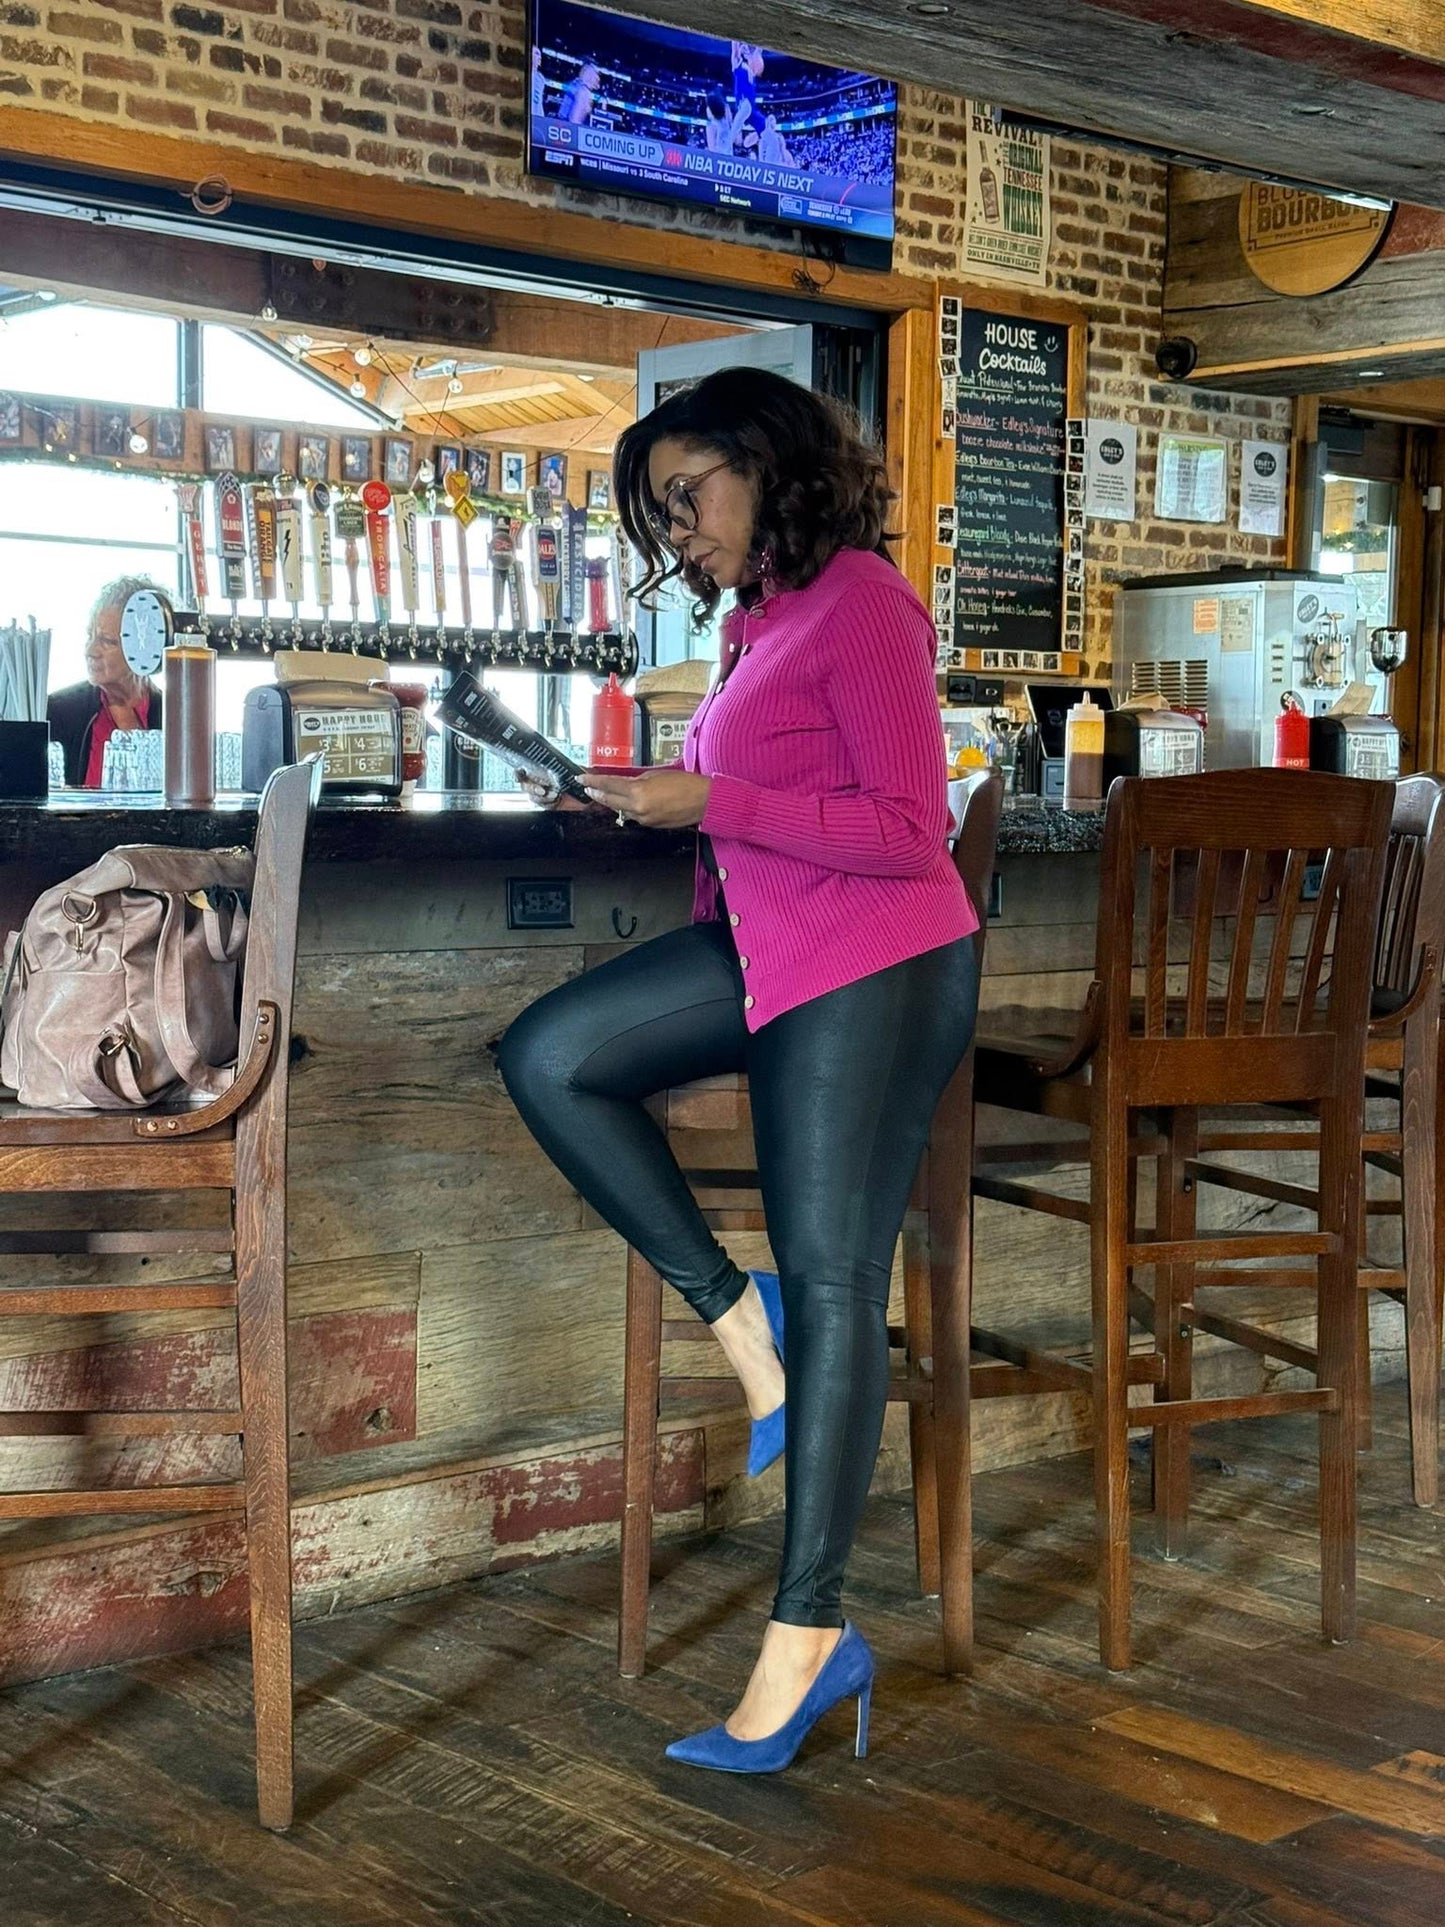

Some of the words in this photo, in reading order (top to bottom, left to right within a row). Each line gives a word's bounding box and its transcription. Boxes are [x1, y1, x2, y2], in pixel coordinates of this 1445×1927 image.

[548, 126, 572, 143] SC
[585, 133, 635, 155] COMING
[638, 145, 656, 159] UP
[1008, 142, 1044, 175] ORIGINAL
[602, 161, 629, 175] Missouri
[644, 169, 662, 181] South
[663, 173, 689, 186] Carolina
[684, 153, 713, 174] NBA
[717, 160, 761, 182] TODAY
[762, 169, 776, 186] IS
[777, 173, 814, 193] NEXT
[1003, 166, 1043, 191] TENNESSEE
[1002, 183, 1043, 238] WHISKEY
[1257, 196, 1366, 233] BOURBO
[967, 249, 985, 259] ONLY
[984, 322, 1038, 350] HOUSE
[979, 347, 1047, 376] Cocktails
[375, 520, 388, 592] TROPICALIA
[574, 533, 583, 618] EASTCIDERS
[322, 715, 356, 725] HAPPY
[596, 746, 619, 756] HOT
[1286, 759, 1304, 767] HOT
